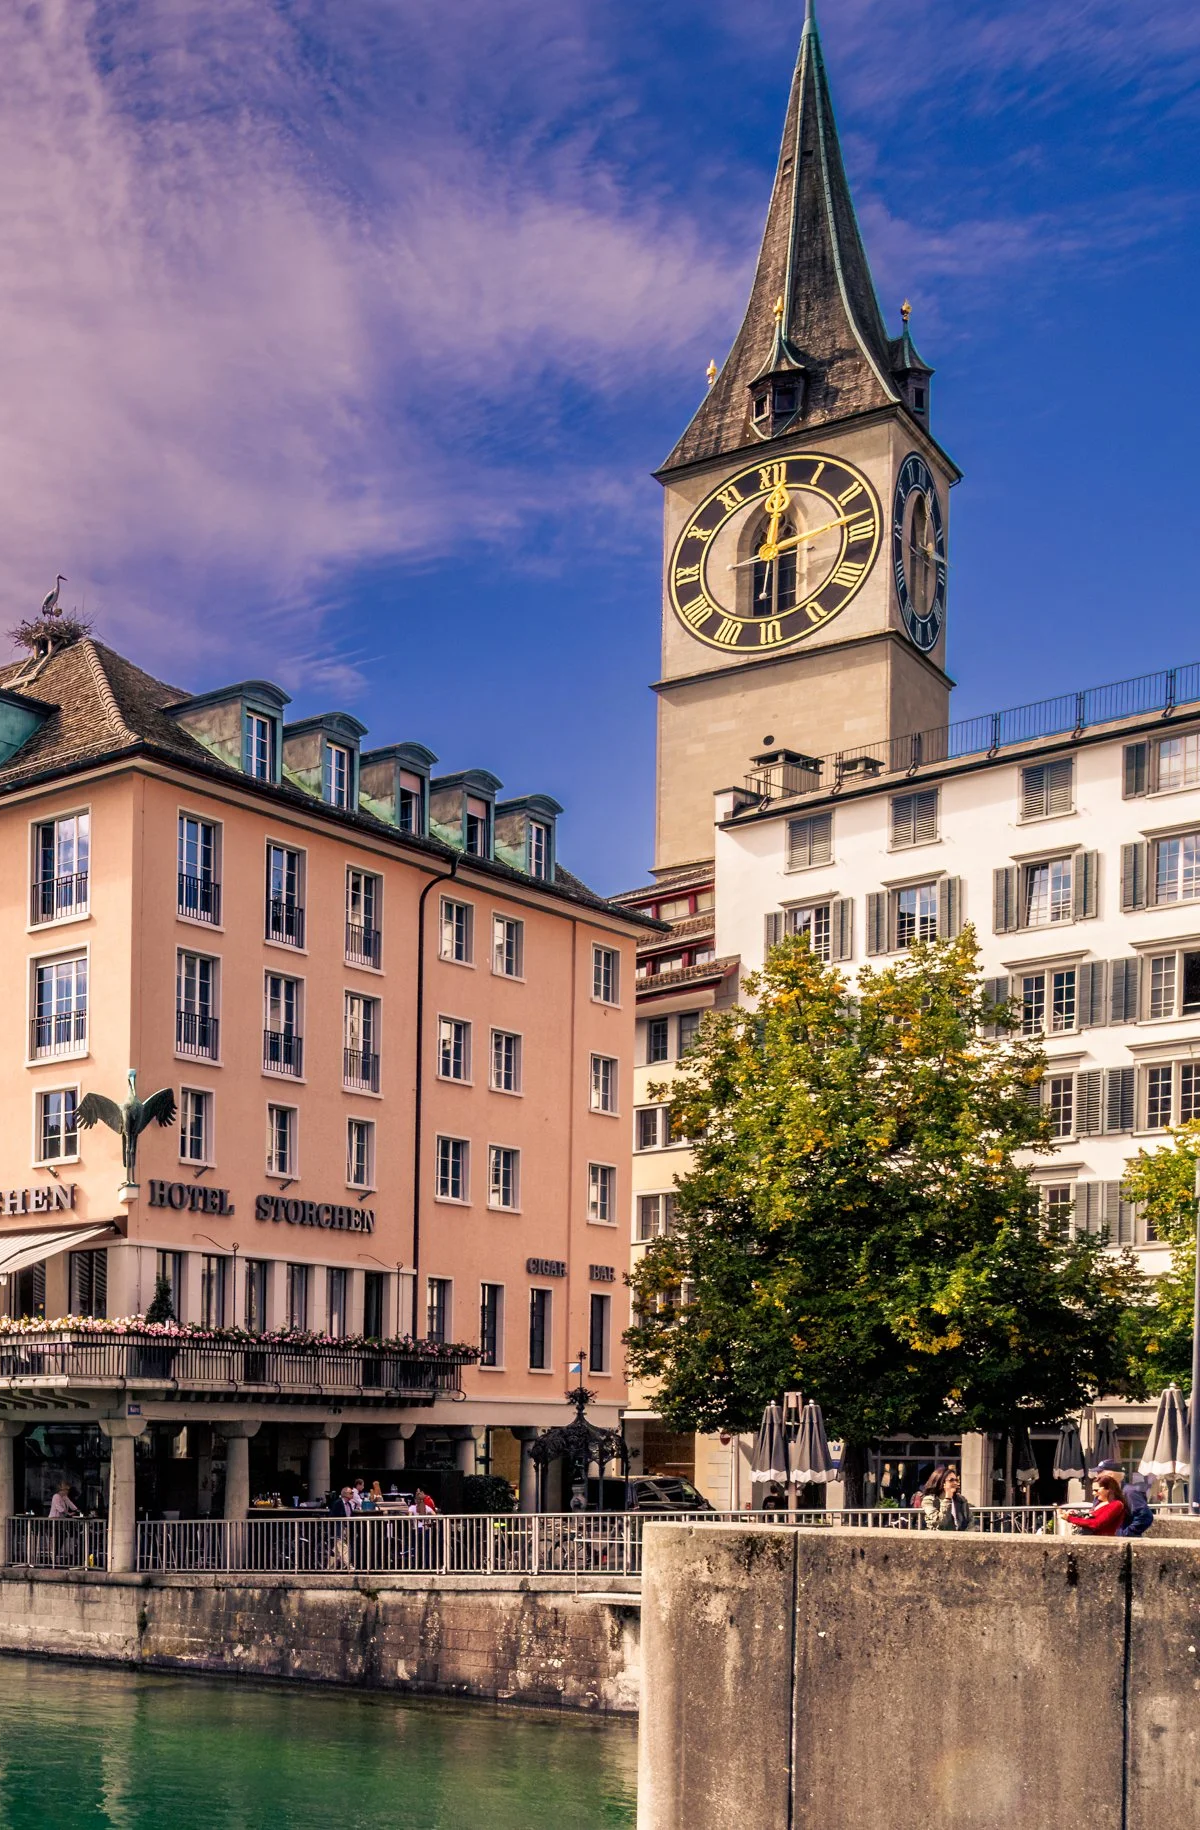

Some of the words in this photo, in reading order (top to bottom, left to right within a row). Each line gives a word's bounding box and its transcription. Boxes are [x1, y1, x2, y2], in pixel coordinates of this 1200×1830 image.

[758, 462, 787, 489] XII
[810, 461, 825, 486] I
[717, 485, 745, 511] XI
[837, 481, 864, 507] II
[687, 525, 712, 542] X
[848, 518, 875, 544] III
[675, 563, 700, 587] IX
[148, 1179, 235, 1216] HOTEL
[255, 1194, 375, 1233] STORCHEN
[526, 1257, 567, 1278] CIGAR
[589, 1264, 616, 1283] BAR
